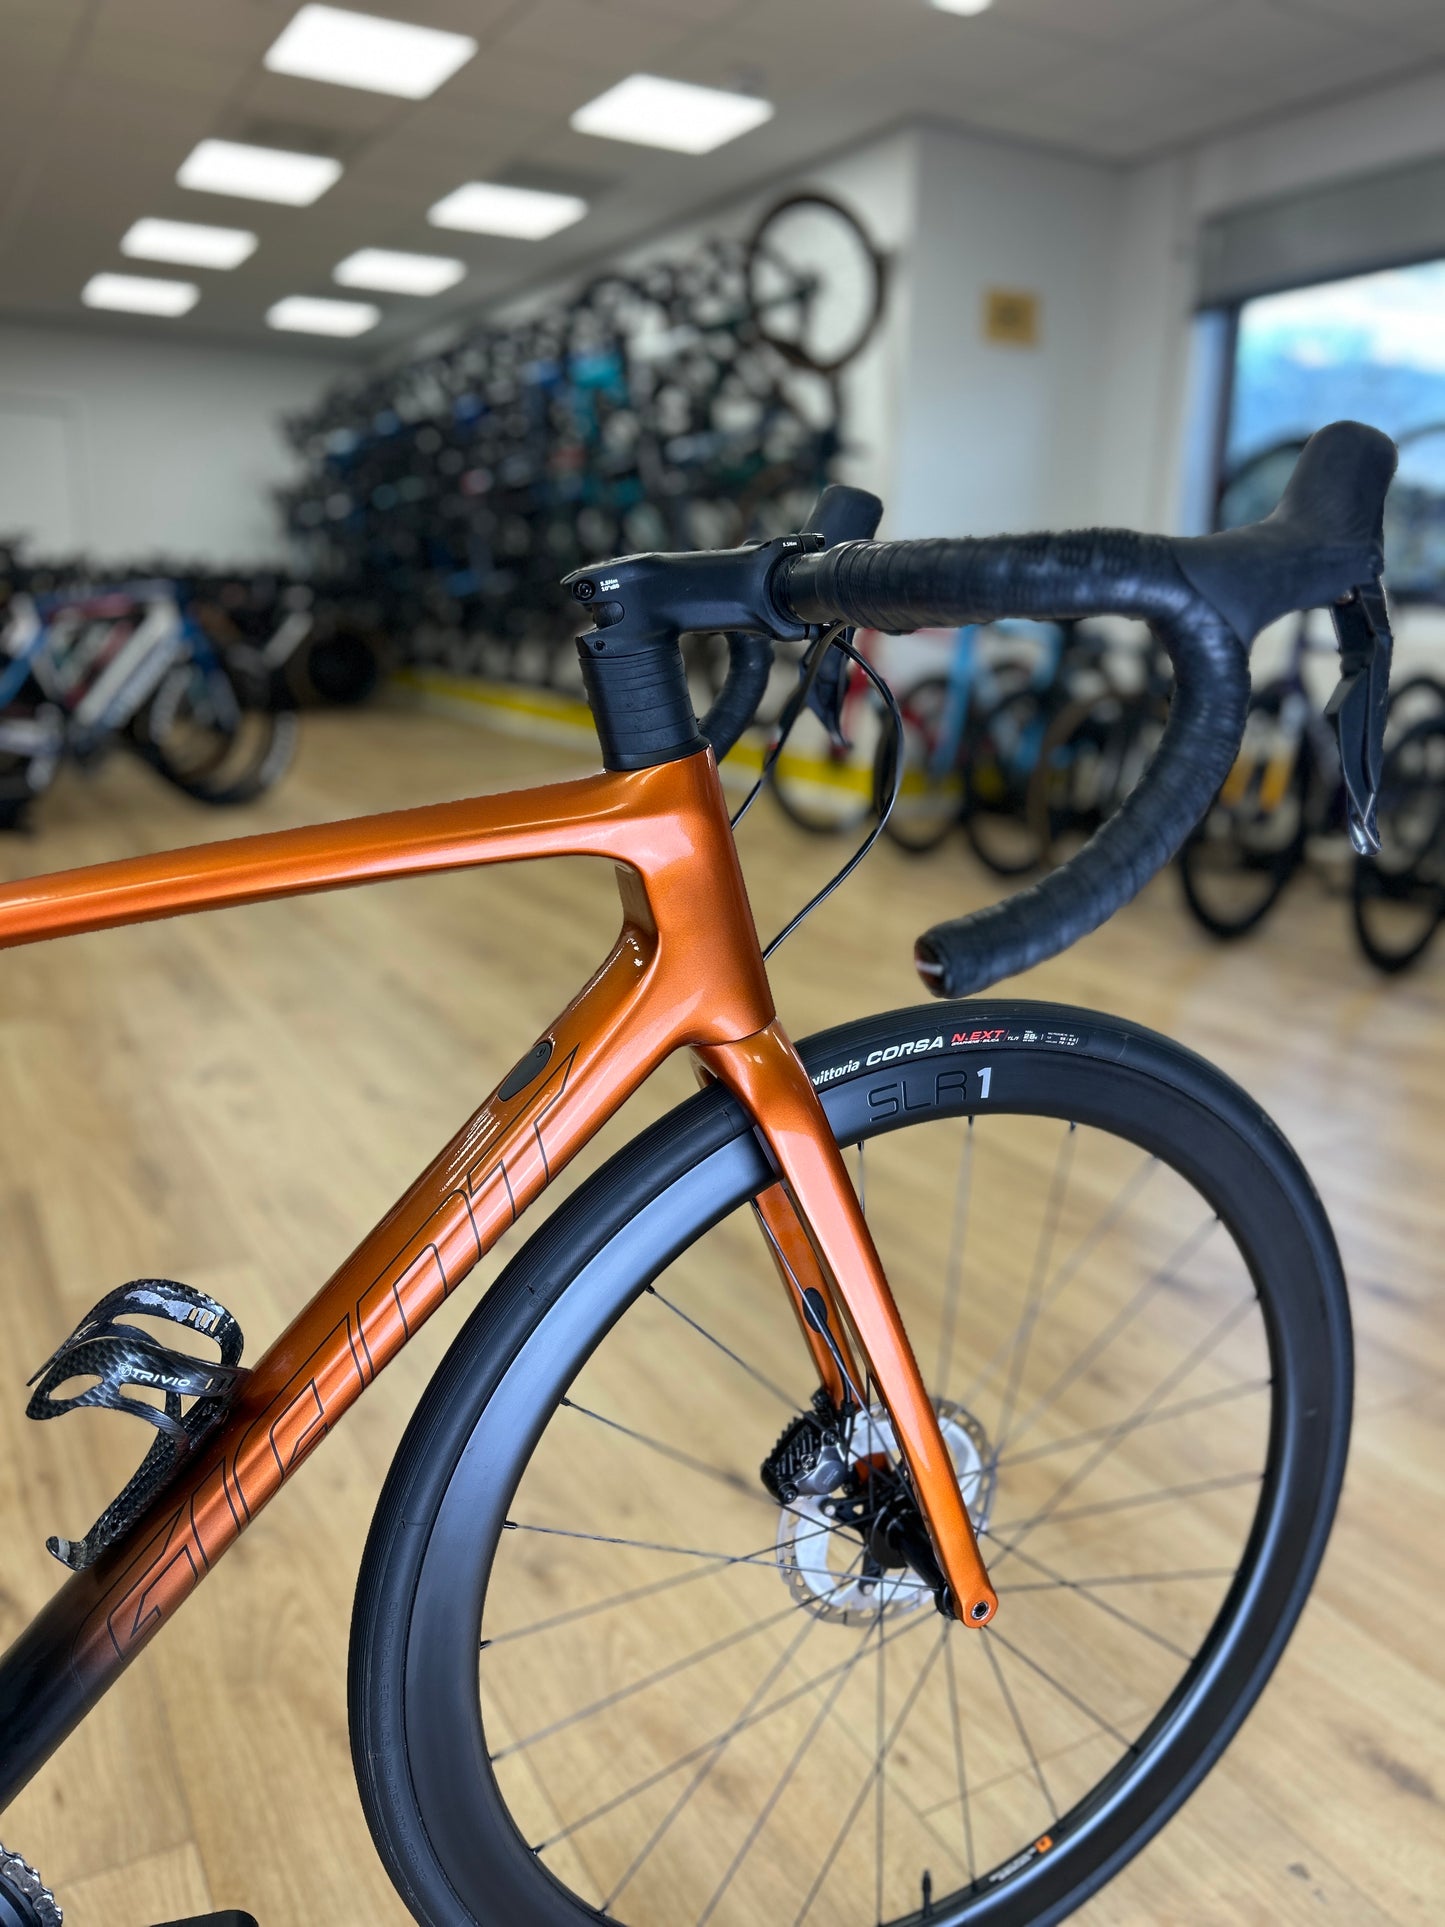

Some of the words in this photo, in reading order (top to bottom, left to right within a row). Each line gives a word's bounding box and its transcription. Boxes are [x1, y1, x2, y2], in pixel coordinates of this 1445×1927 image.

[812, 1059, 860, 1086] vittoria
[865, 1036, 944, 1067] CORSA
[950, 1029, 1005, 1044] N.EXT
[866, 1070, 968, 1123] SLR
[976, 1066, 993, 1100] 1
[72, 1042, 580, 1688] GIANT
[131, 1367, 191, 1387] TRIVIO
